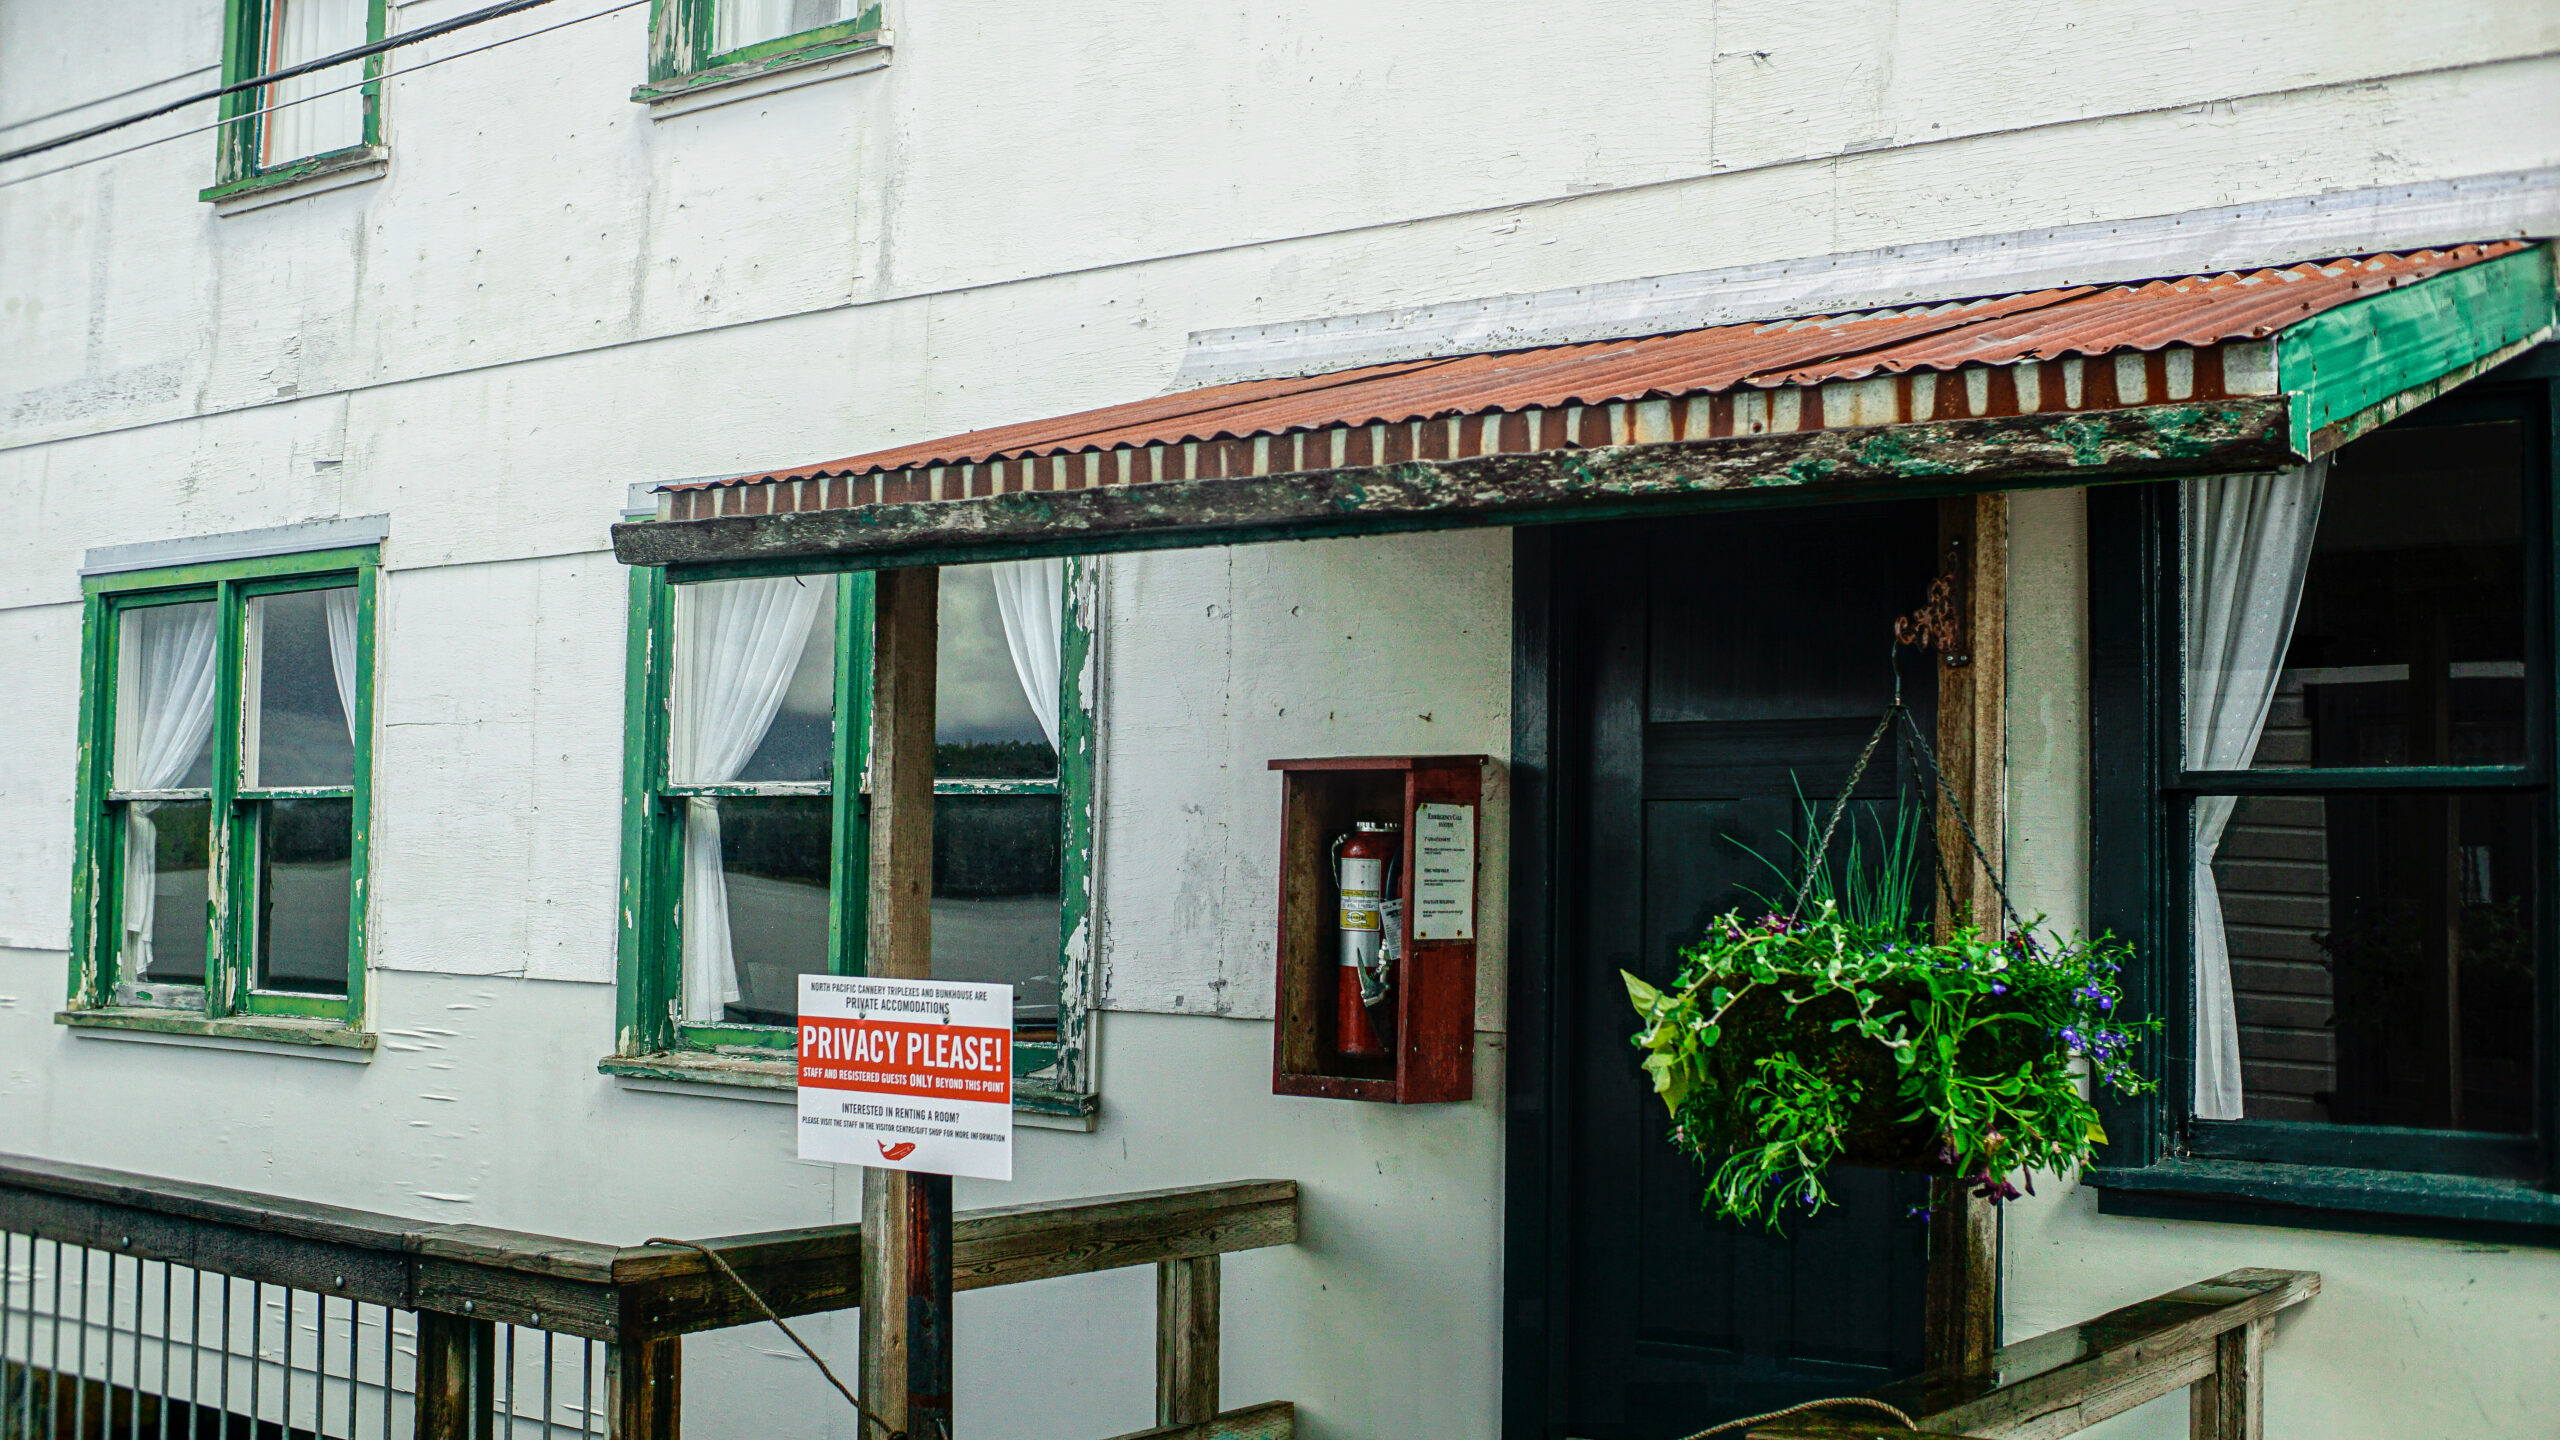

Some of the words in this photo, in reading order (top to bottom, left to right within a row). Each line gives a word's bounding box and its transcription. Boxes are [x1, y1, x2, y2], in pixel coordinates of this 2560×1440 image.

[811, 982, 831, 992] NORTH
[832, 984, 856, 993] PACIFIC
[858, 985, 885, 995] CANNERY
[888, 987, 919, 996] TRIPLEXES
[922, 989, 934, 997] AND
[936, 989, 973, 1000] BUNKHOUSE
[975, 992, 987, 1001] ARE
[846, 997, 878, 1010] PRIVATE
[881, 999, 950, 1014] ACCOMODATIONS
[803, 1026, 899, 1064] PRIVACY
[908, 1032, 1002, 1072] PLEASE!
[803, 1067, 823, 1078] STAFF
[824, 1069, 837, 1079] AND
[839, 1070, 879, 1082] REGISTERED
[882, 1073, 907, 1084] GUESTS
[910, 1074, 932, 1088] ONLY
[936, 1078, 963, 1089] BEYOND
[965, 1080, 980, 1090] THIS
[983, 1082, 1004, 1093] POINT
[842, 1103, 883, 1116] INTERESTED
[886, 1107, 893, 1116] IN
[895, 1108, 925, 1120] RENTING
[928, 1111, 932, 1121] A
[934, 1111, 959, 1123] ROOM?
[802, 1116, 819, 1124] PLEASE
[821, 1118, 832, 1126] VISIT
[834, 1119, 842, 1127] THE
[844, 1120, 858, 1128] STAFF
[865, 1122, 874, 1130] THE
[876, 1123, 894, 1131] VISITOR
[896, 1125, 927, 1134] CENTRE/GIFT
[929, 1128, 942, 1136] SHOP
[943, 1129, 954, 1137] FOR
[955, 1130, 969, 1139] MORE
[970, 1132, 1005, 1142] INFORMATION
